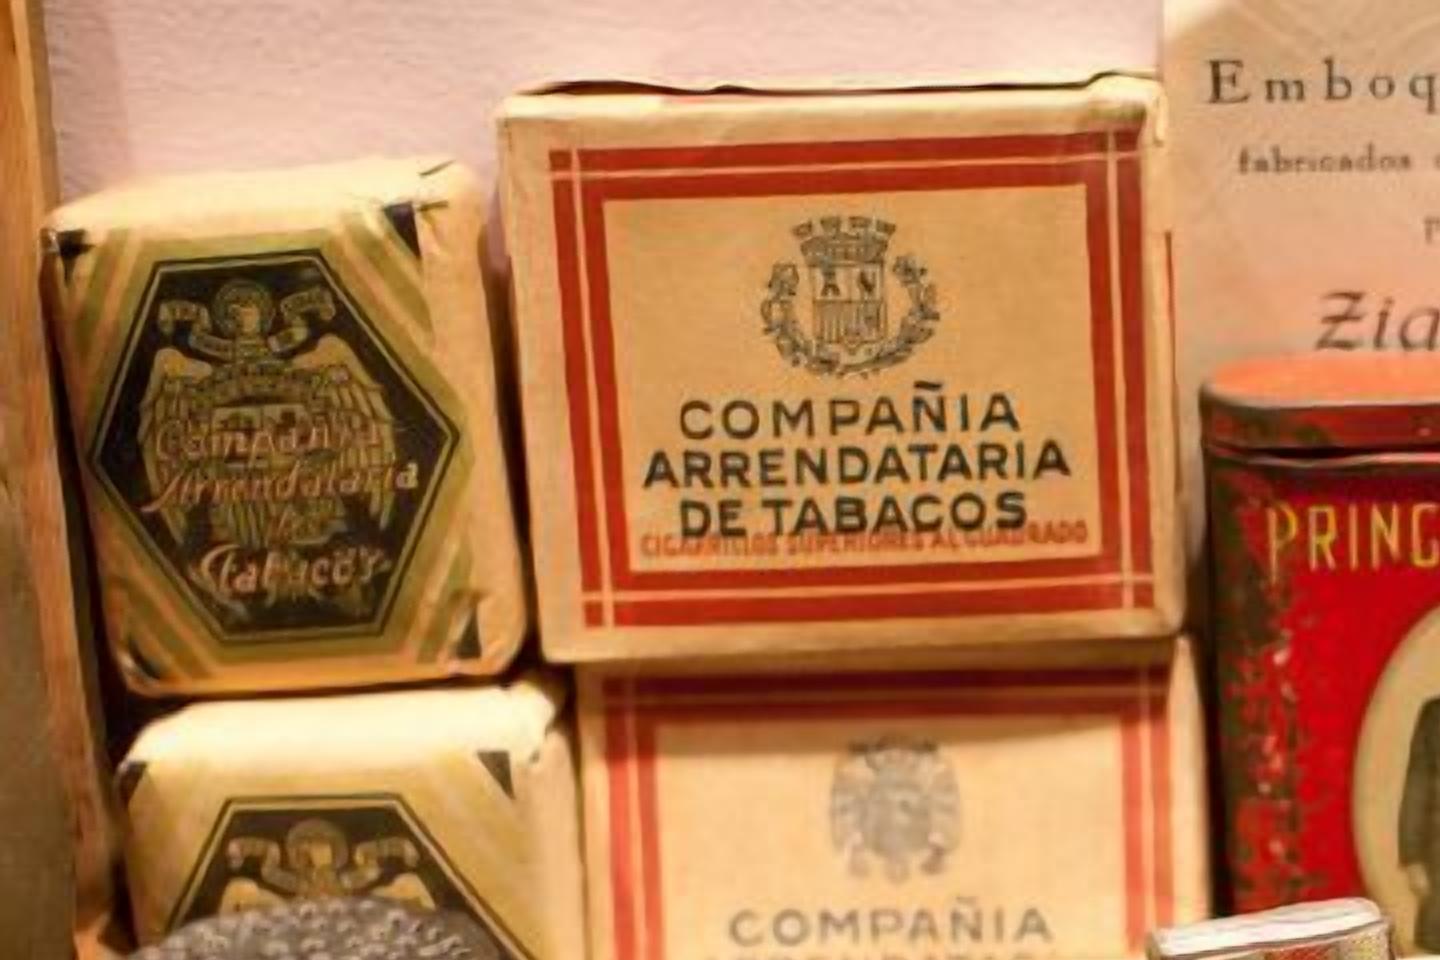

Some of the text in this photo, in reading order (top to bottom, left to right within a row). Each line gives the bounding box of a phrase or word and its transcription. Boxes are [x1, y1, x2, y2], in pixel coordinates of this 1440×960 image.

[1238, 141, 1412, 174] fabricados
[679, 381, 1020, 440] COMPAÑIA
[643, 439, 1071, 489] ARRENDATARIA
[679, 490, 1028, 538] DE TABACOS
[728, 896, 1054, 948] COMPAÑIA
